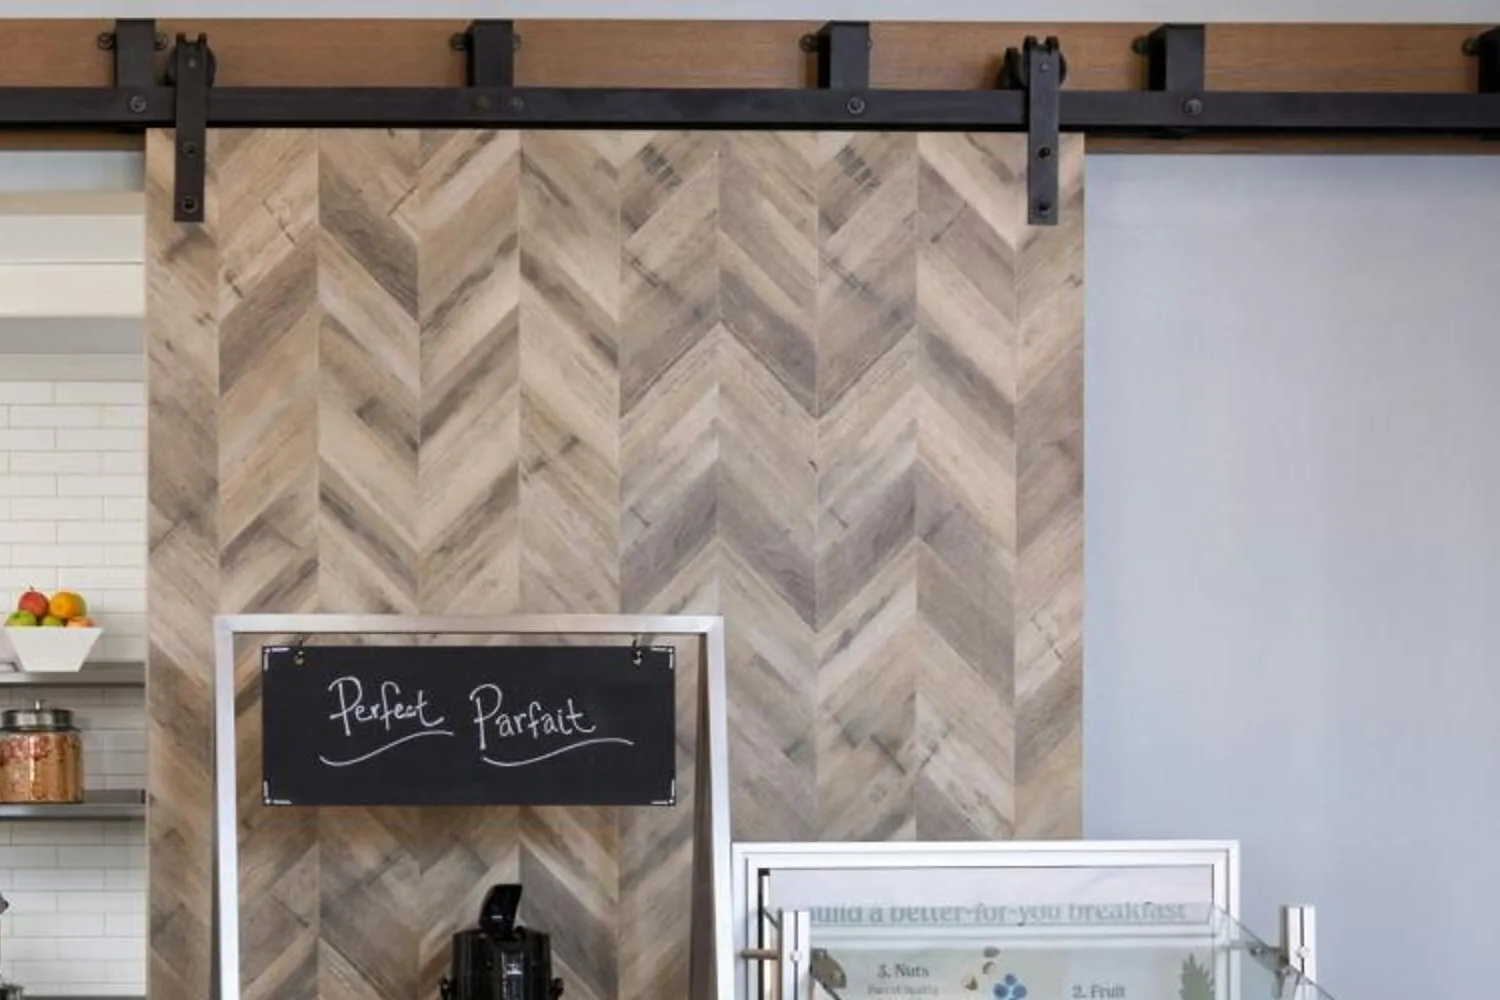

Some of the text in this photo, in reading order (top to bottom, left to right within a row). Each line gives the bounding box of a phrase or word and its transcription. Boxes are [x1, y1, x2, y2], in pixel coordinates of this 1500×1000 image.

[328, 676, 596, 750] Perfect Parfait
[894, 963, 930, 977] Nuts
[1090, 983, 1126, 998] Fruit
